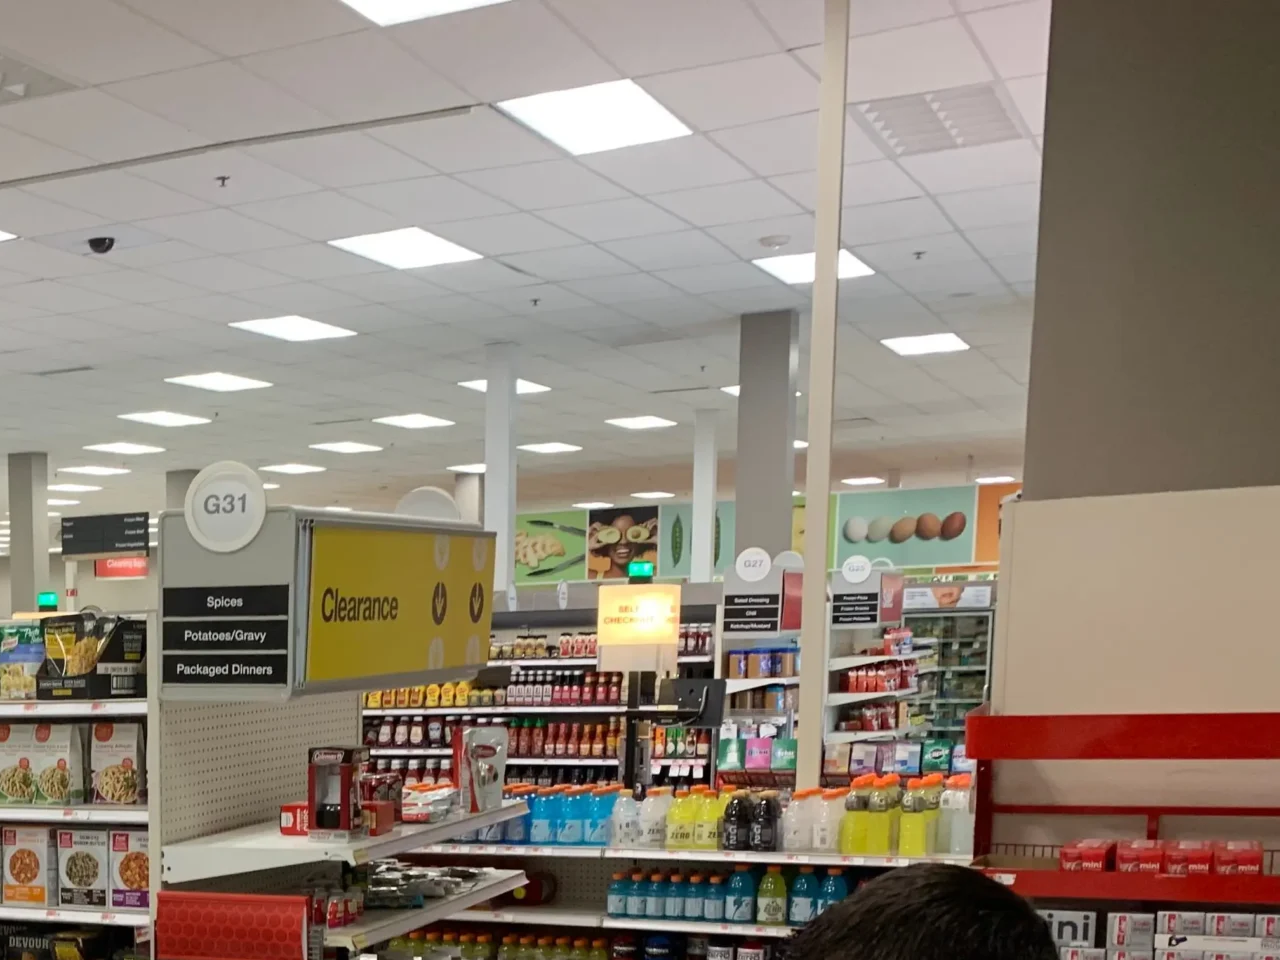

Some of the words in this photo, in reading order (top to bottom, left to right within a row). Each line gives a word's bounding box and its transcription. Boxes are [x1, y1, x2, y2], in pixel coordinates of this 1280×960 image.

[203, 494, 247, 515] G31
[744, 559, 764, 569] G27
[206, 595, 243, 609] Spices
[320, 587, 399, 623] Clearance
[184, 629, 266, 644] Potatoes/Gravy
[176, 663, 229, 678] Packaged
[231, 663, 273, 676] Dinners
[670, 831, 690, 840] ZERO
[1082, 861, 1103, 869] mini
[1139, 862, 1160, 870] mini
[1188, 863, 1209, 871] mini
[1238, 864, 1260, 872] mini
[1046, 912, 1091, 941] ini
[9, 936, 50, 950] DEVOUR
